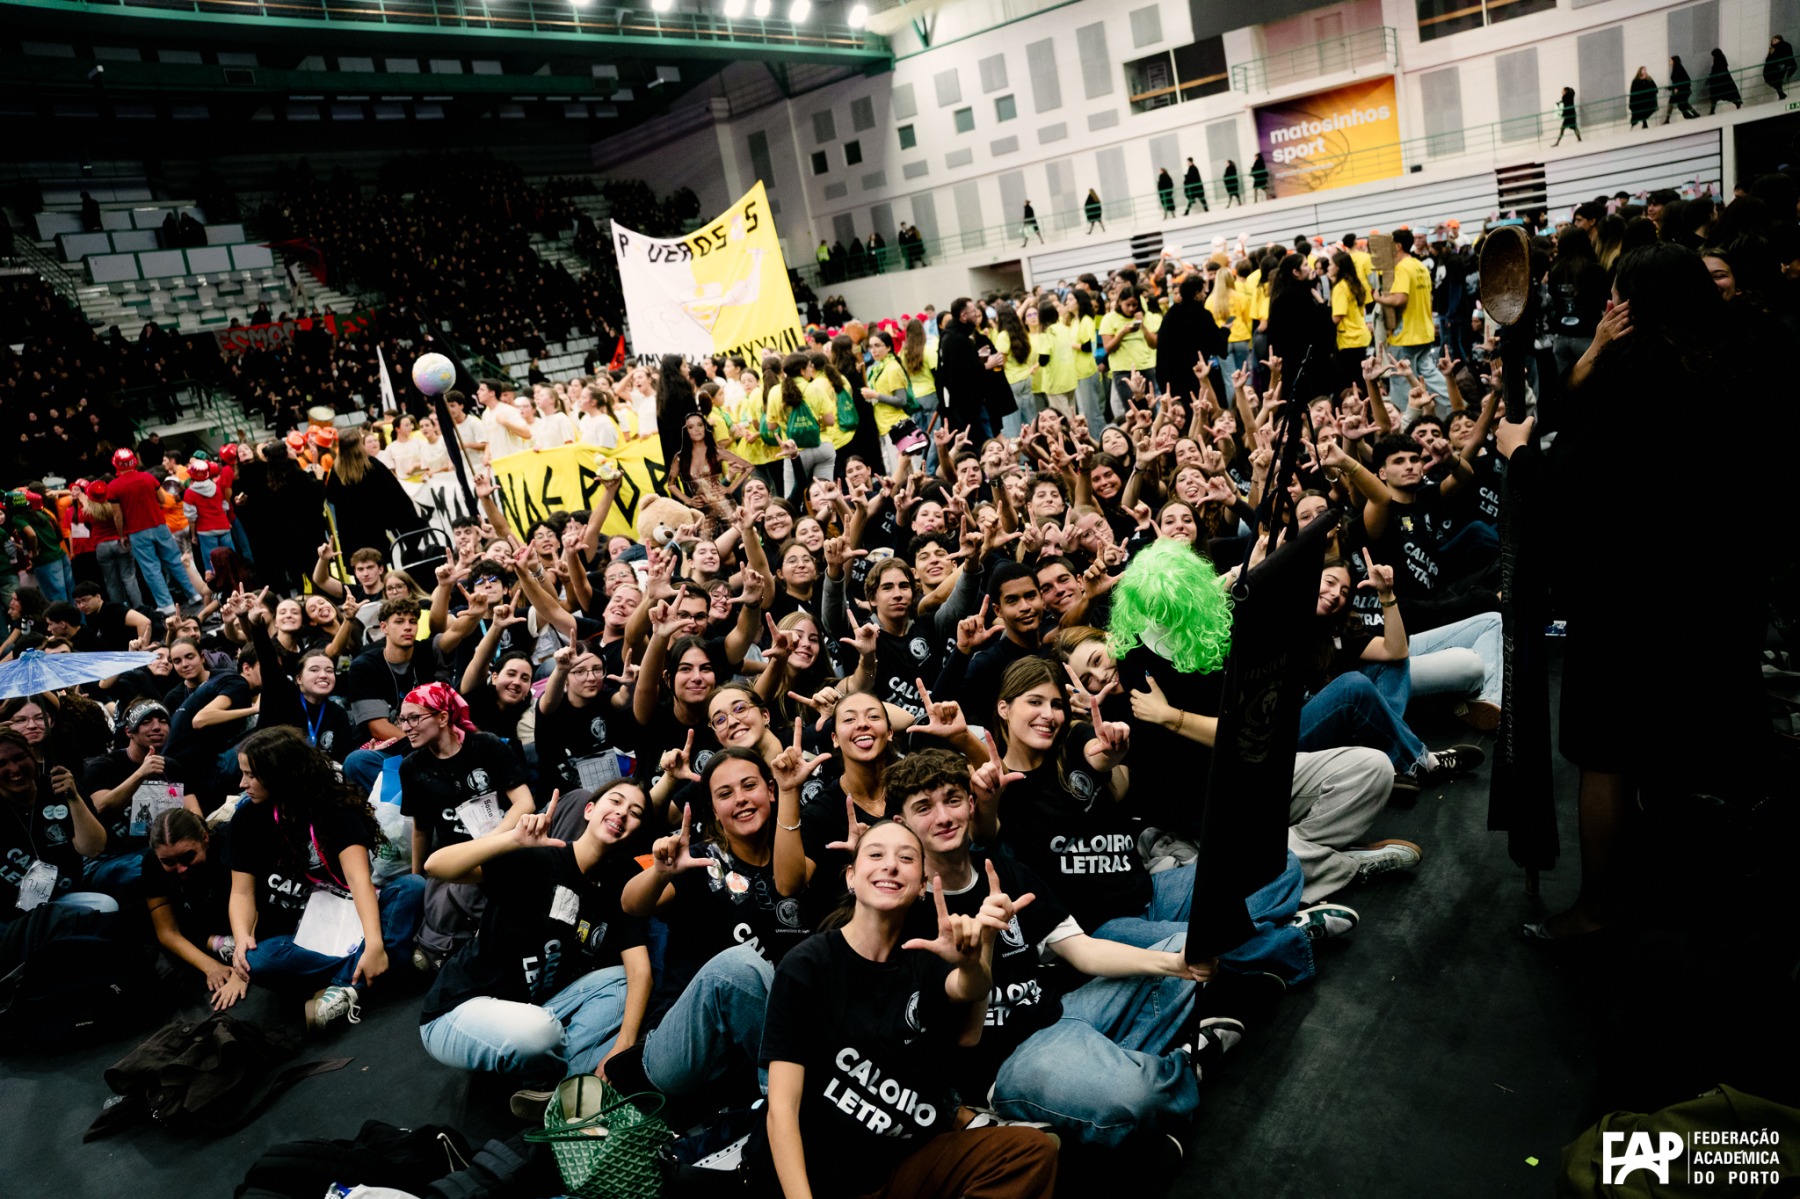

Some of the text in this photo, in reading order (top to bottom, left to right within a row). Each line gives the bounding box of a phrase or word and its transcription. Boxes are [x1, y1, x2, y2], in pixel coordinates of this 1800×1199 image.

[1270, 106, 1390, 144] matosinhos
[1272, 137, 1326, 164] sport
[1049, 834, 1135, 854] CALOIRO
[1060, 854, 1132, 874] LETRAS
